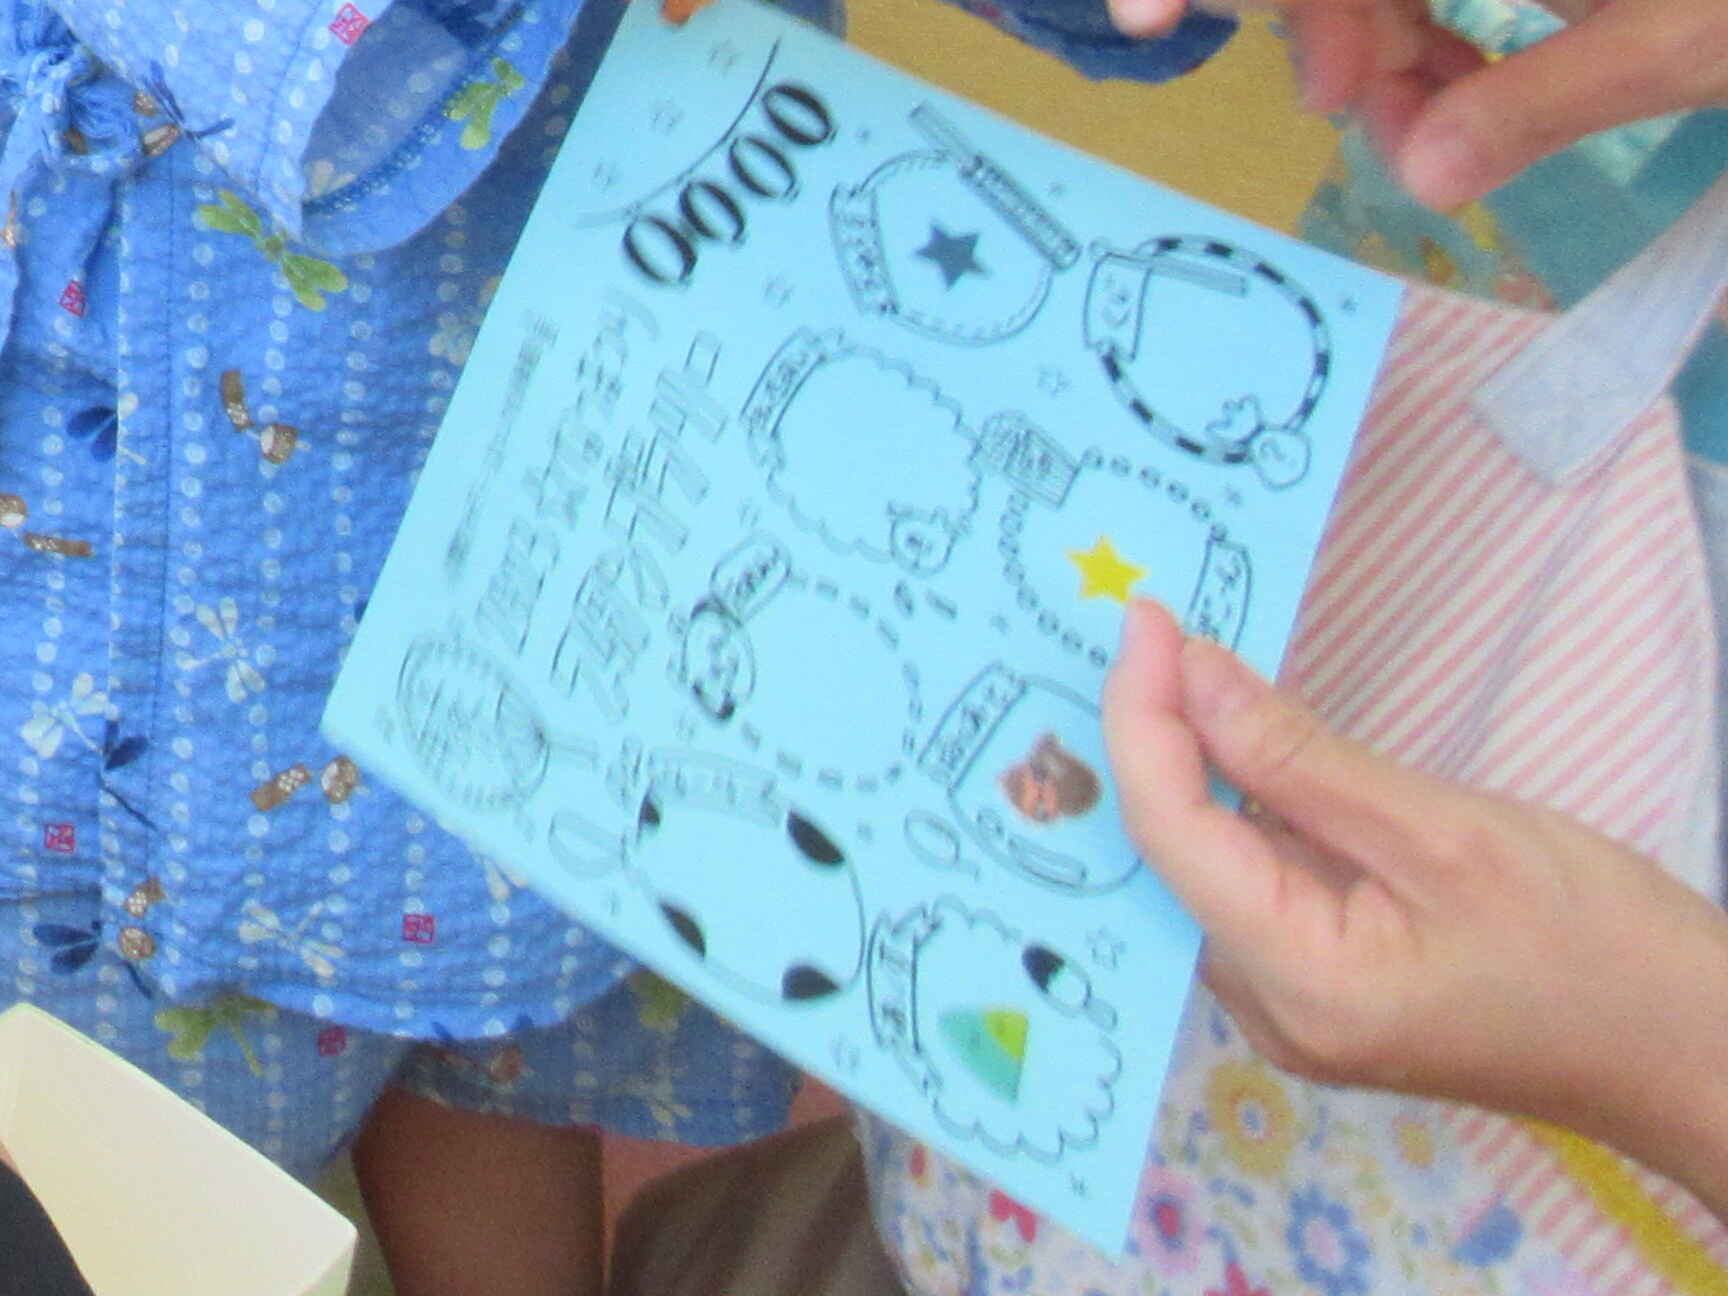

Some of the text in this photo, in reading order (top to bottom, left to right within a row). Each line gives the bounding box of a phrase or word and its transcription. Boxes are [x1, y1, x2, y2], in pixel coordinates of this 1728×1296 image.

[547, 326, 734, 721] スタンプラリー
